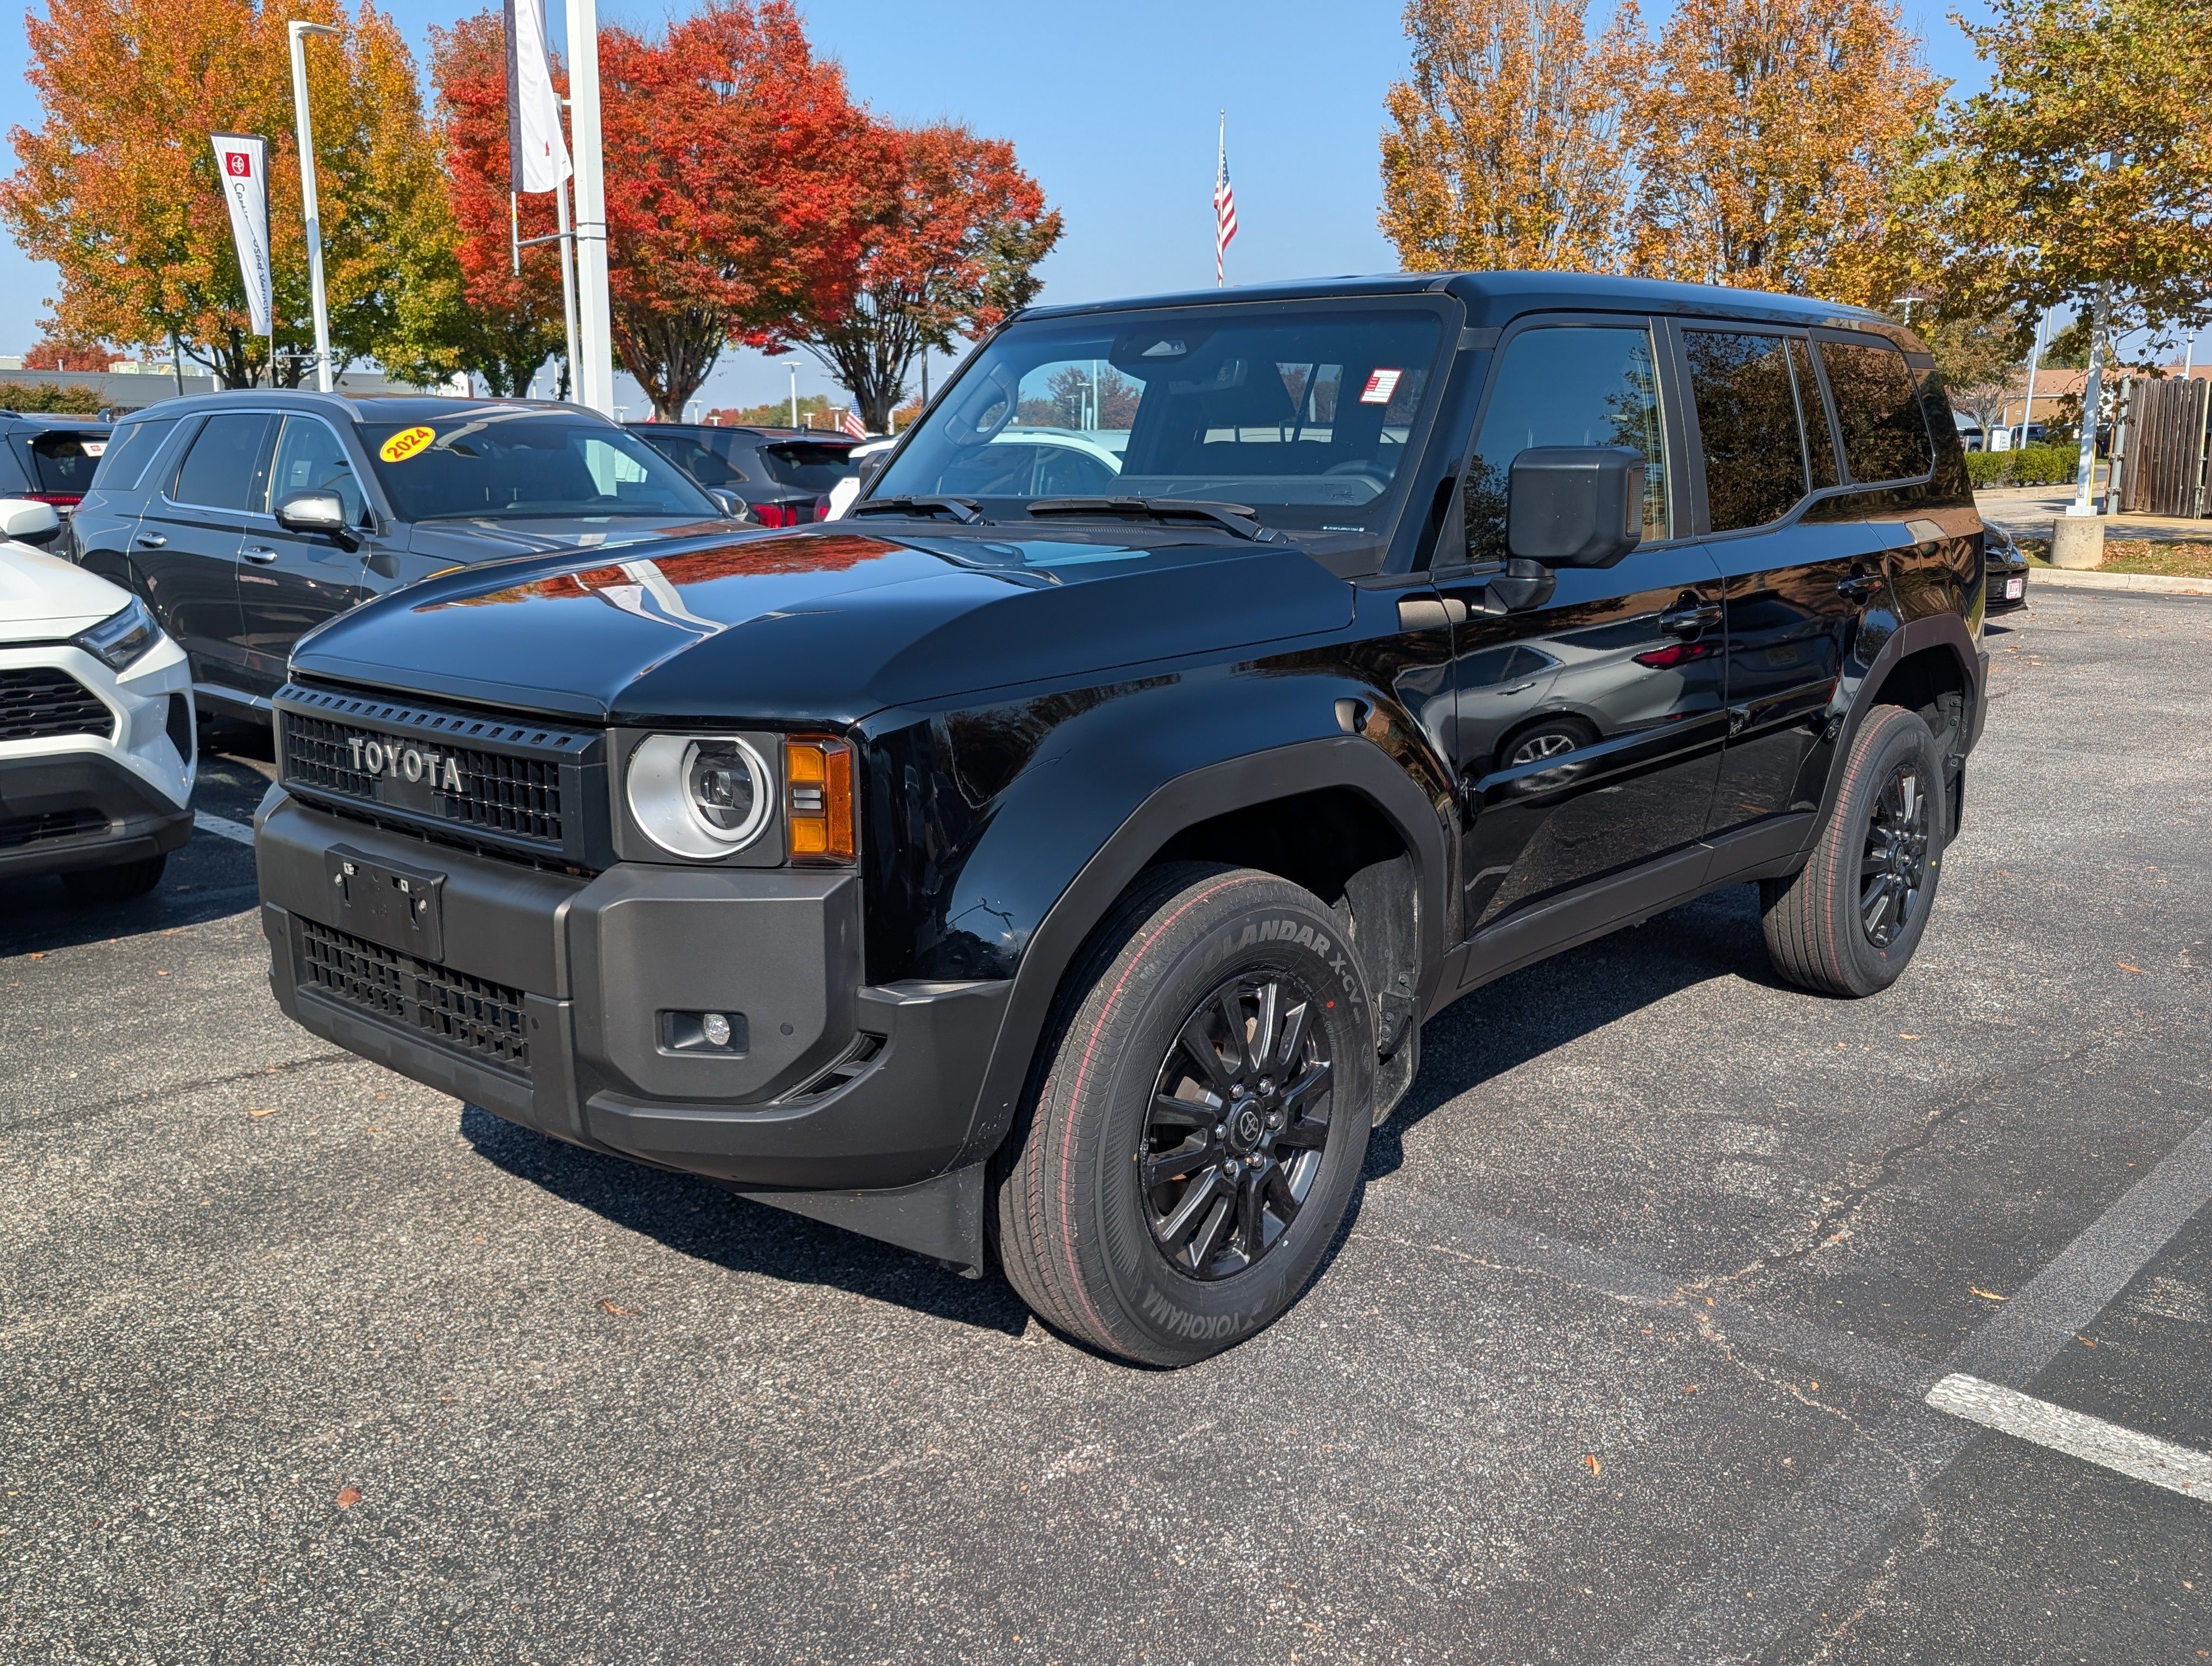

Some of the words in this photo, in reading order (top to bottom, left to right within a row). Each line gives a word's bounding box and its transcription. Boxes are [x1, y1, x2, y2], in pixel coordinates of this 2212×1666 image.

[386, 429, 430, 459] 2024
[348, 737, 462, 792] TOYOTA
[1175, 920, 1331, 1011] GEOLANDAR
[1329, 951, 1362, 1003] X-CV
[1142, 1283, 1240, 1340] YOKOHAMA
